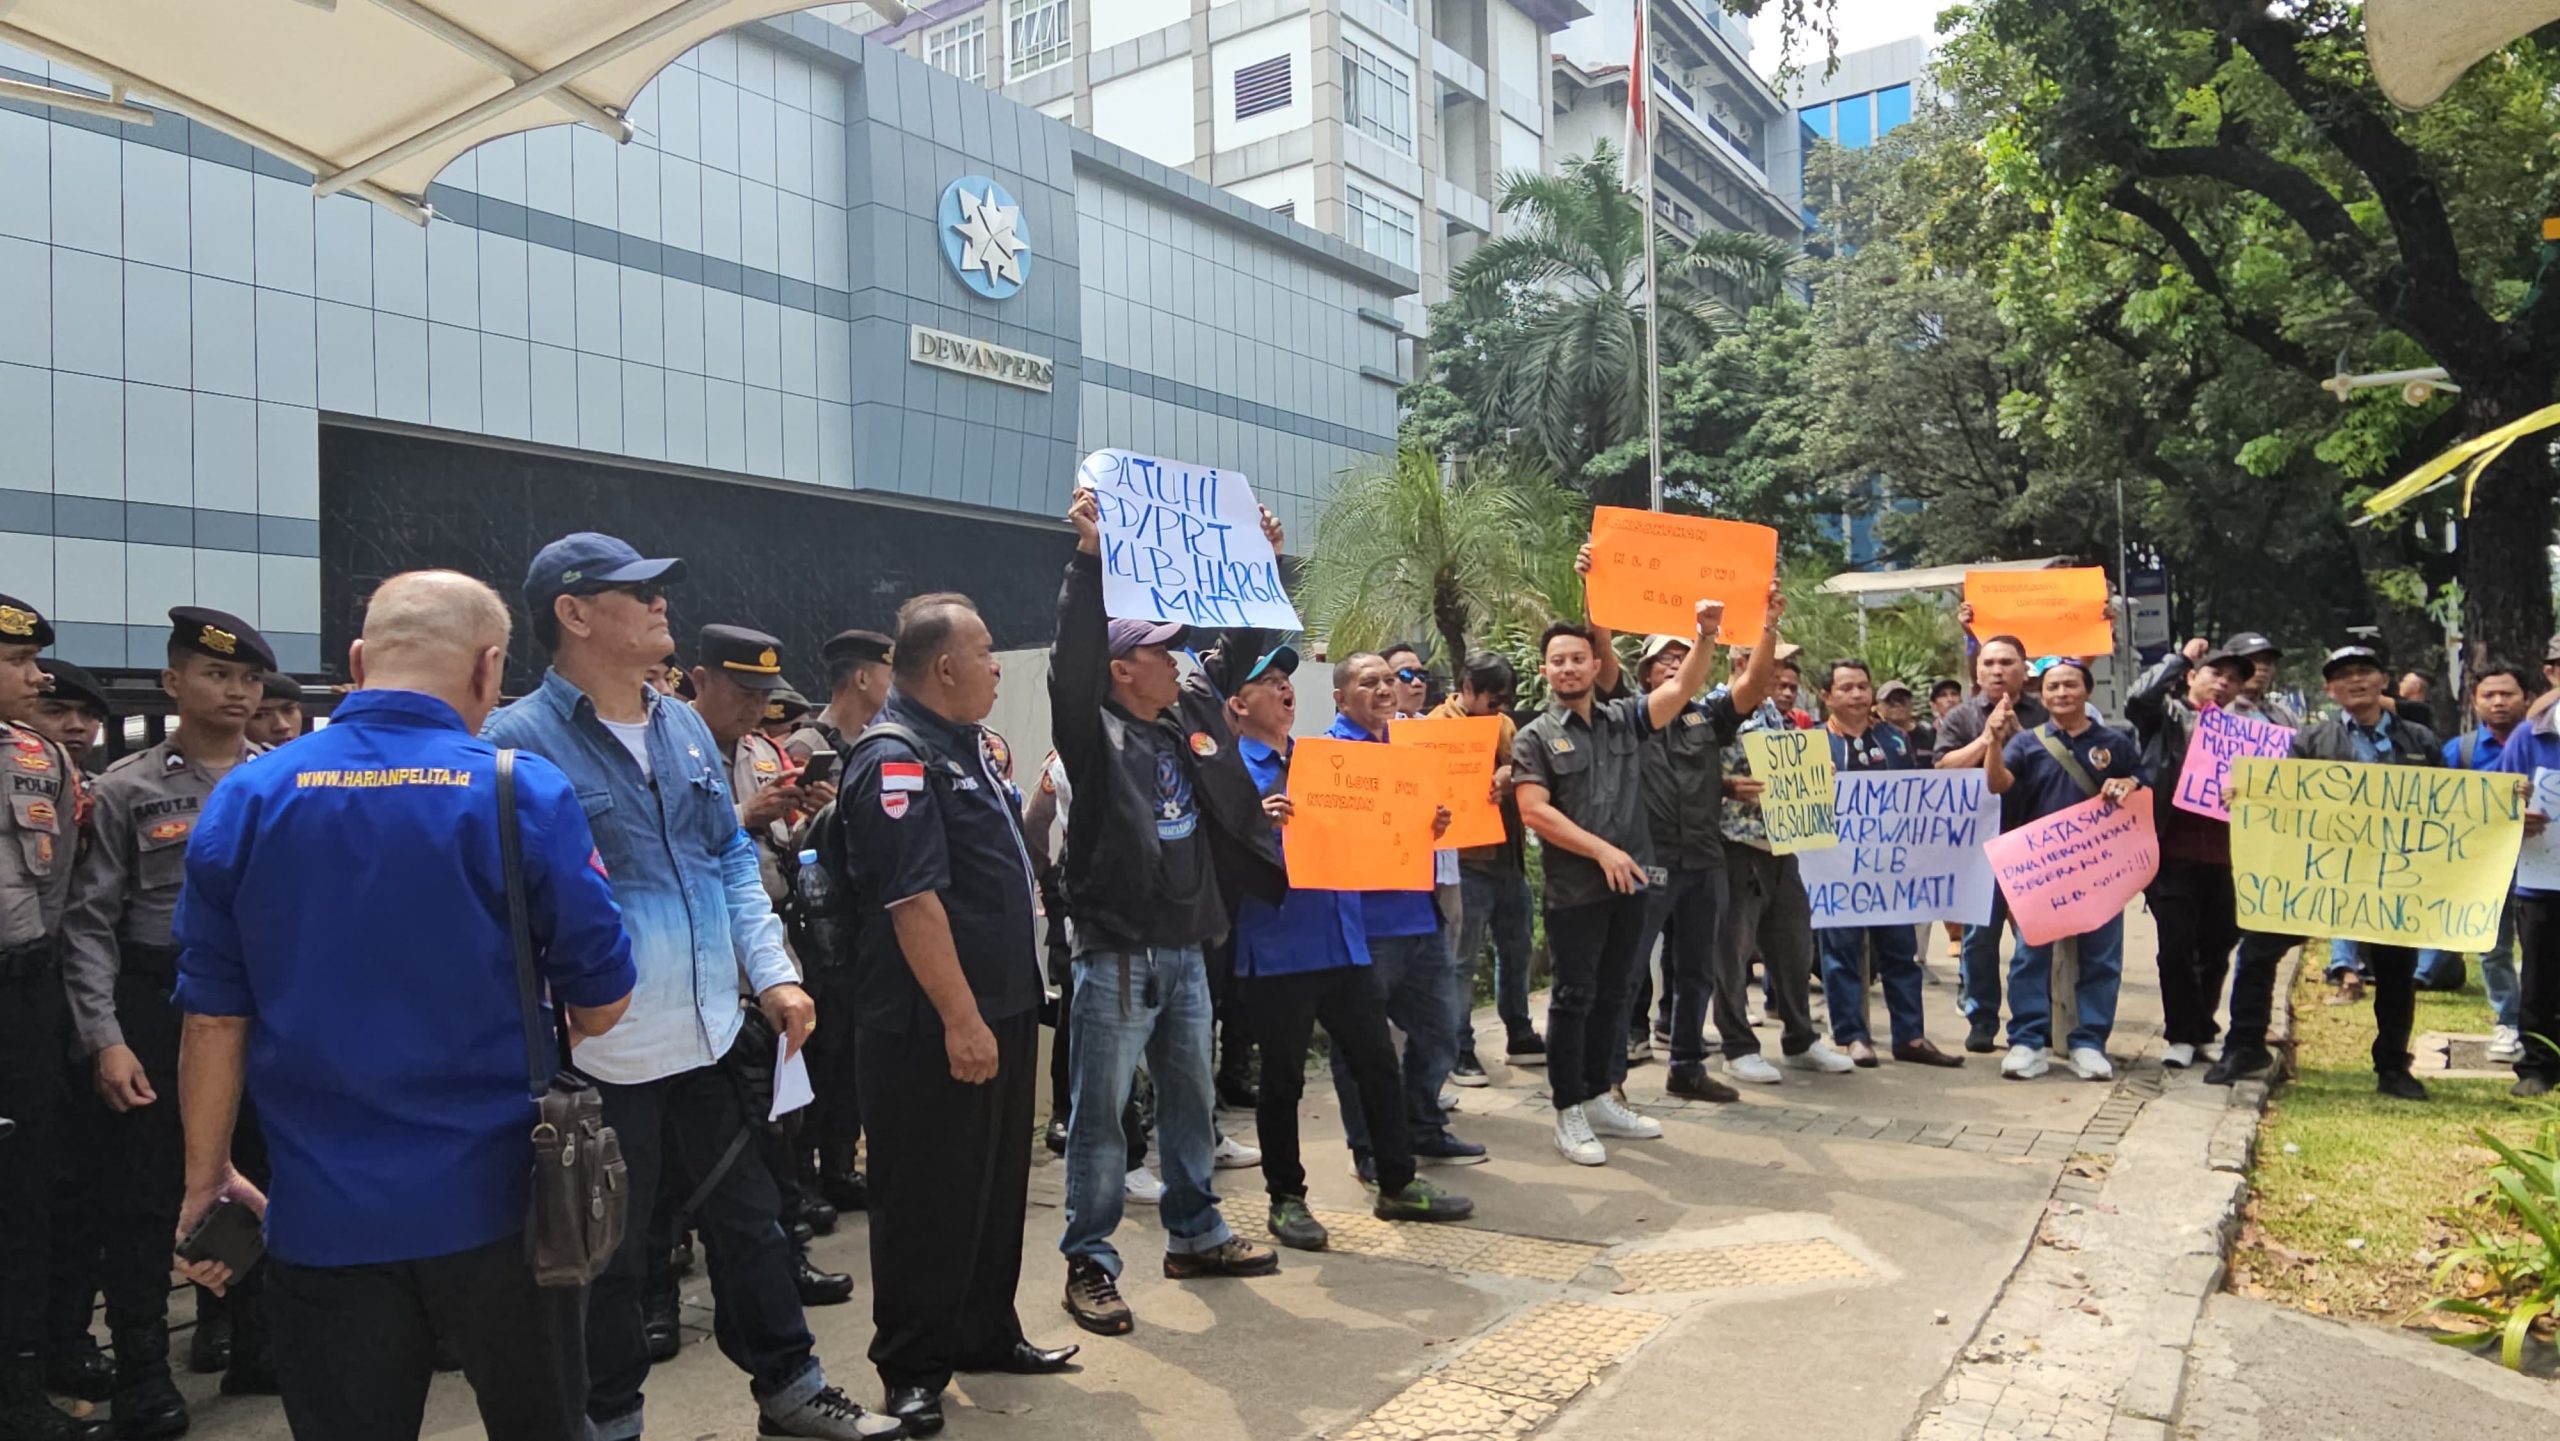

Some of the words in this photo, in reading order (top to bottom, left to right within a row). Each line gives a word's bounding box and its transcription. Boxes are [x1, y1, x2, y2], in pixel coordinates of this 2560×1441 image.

[1104, 532, 1186, 589] KLB
[1193, 553, 1289, 606] HARGA
[1765, 733, 1807, 770] STOP
[1834, 777, 1981, 817] LAMATKAN
[2246, 764, 2520, 824] LAKSANAKAN
[1929, 817, 1977, 848] PWI
[2026, 820, 2083, 851] KATA
[1851, 846, 1908, 877] KLB
[2304, 843, 2423, 890] KLB
[1892, 873, 1956, 915] MATI
